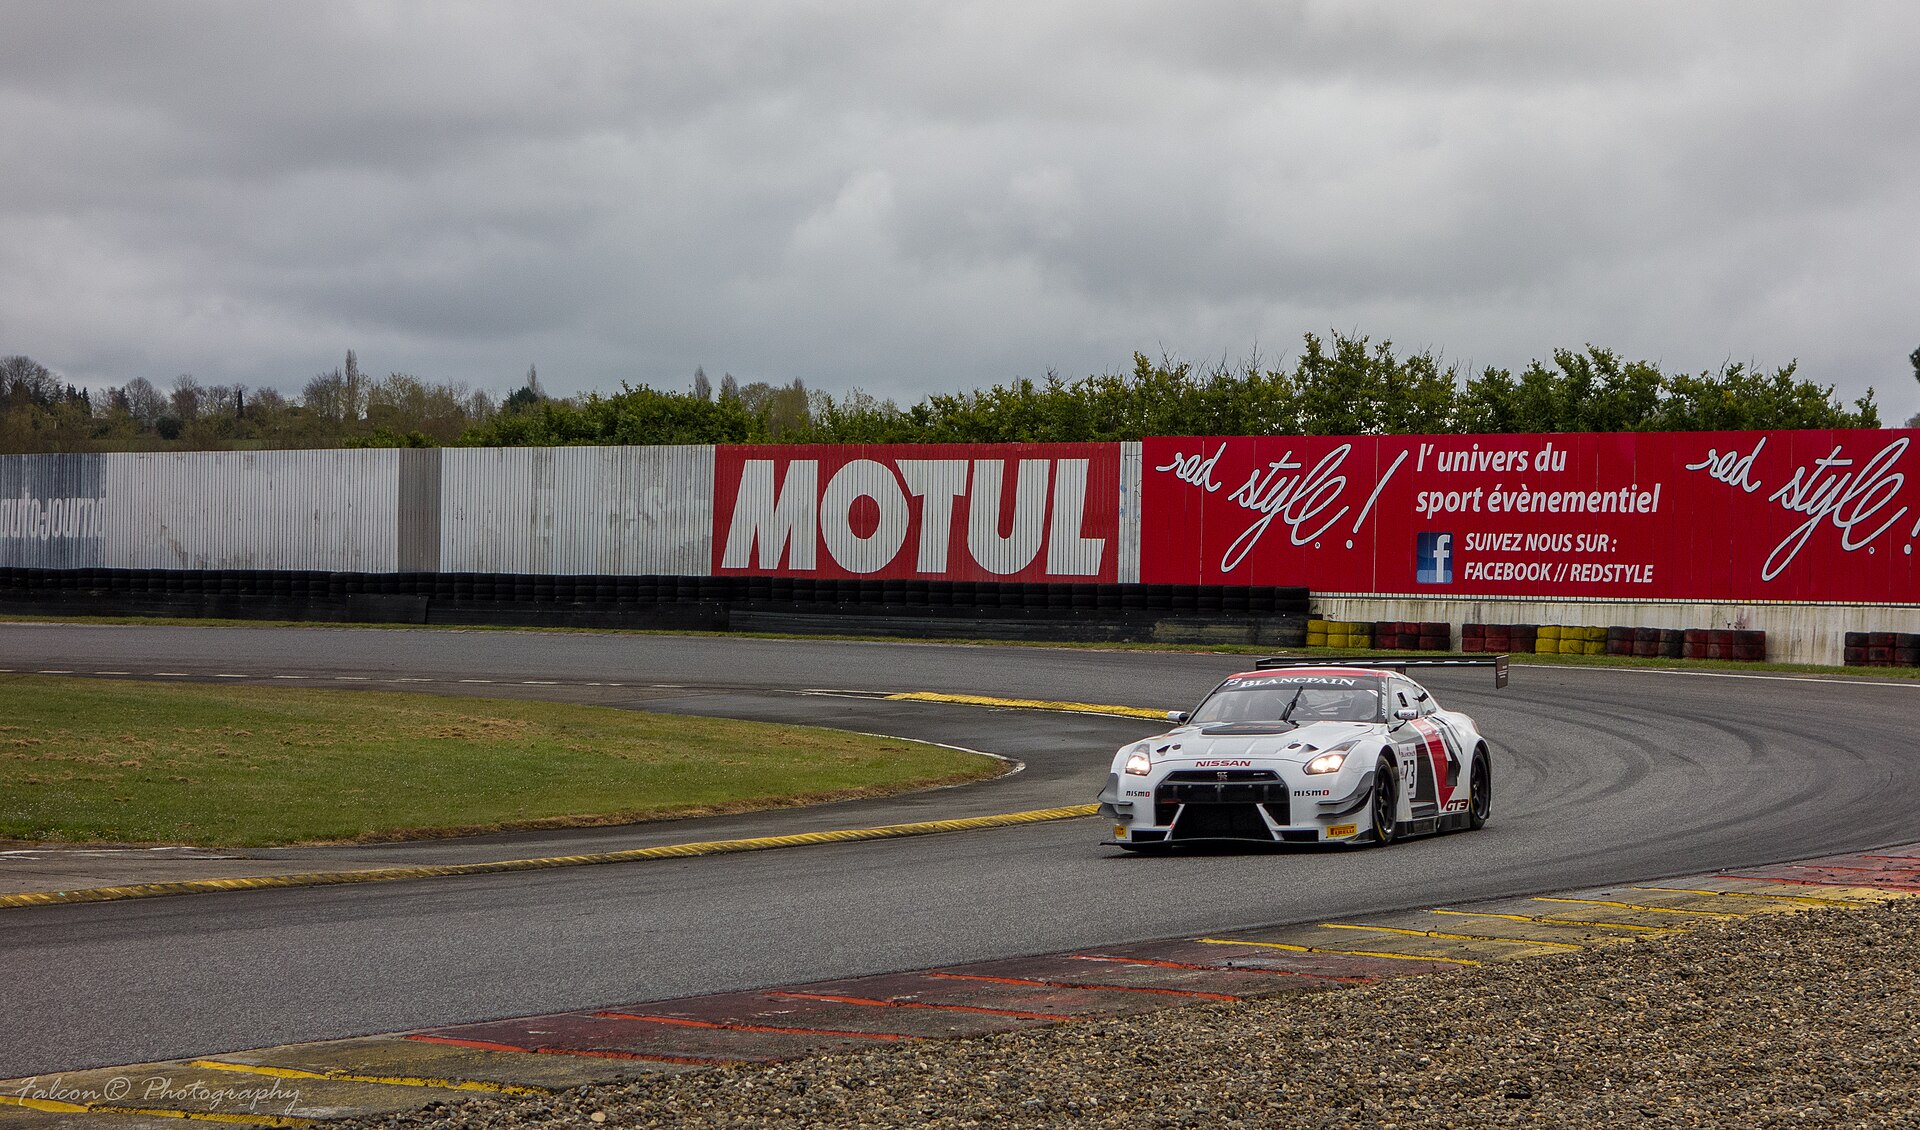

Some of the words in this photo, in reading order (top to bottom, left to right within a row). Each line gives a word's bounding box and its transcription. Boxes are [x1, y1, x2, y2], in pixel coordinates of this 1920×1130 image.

[1156, 442, 1226, 492] red
[1437, 443, 1529, 472] univers
[1534, 442, 1567, 472] du
[1685, 436, 1766, 493] red
[1416, 486, 1483, 519] sport
[1487, 483, 1661, 513] évènementiel
[721, 458, 1106, 576] MOTUL
[1465, 533, 1523, 551] SUIVEZ
[1525, 533, 1573, 552] NOUS
[1575, 534, 1610, 552] SUR
[1465, 562, 1552, 581] FACEBOOK
[1570, 564, 1654, 583] REDSTYLE
[1240, 677, 1357, 688] BLANCPAIN
[1403, 760, 1415, 788] 73
[1446, 799, 1469, 811] GT3
